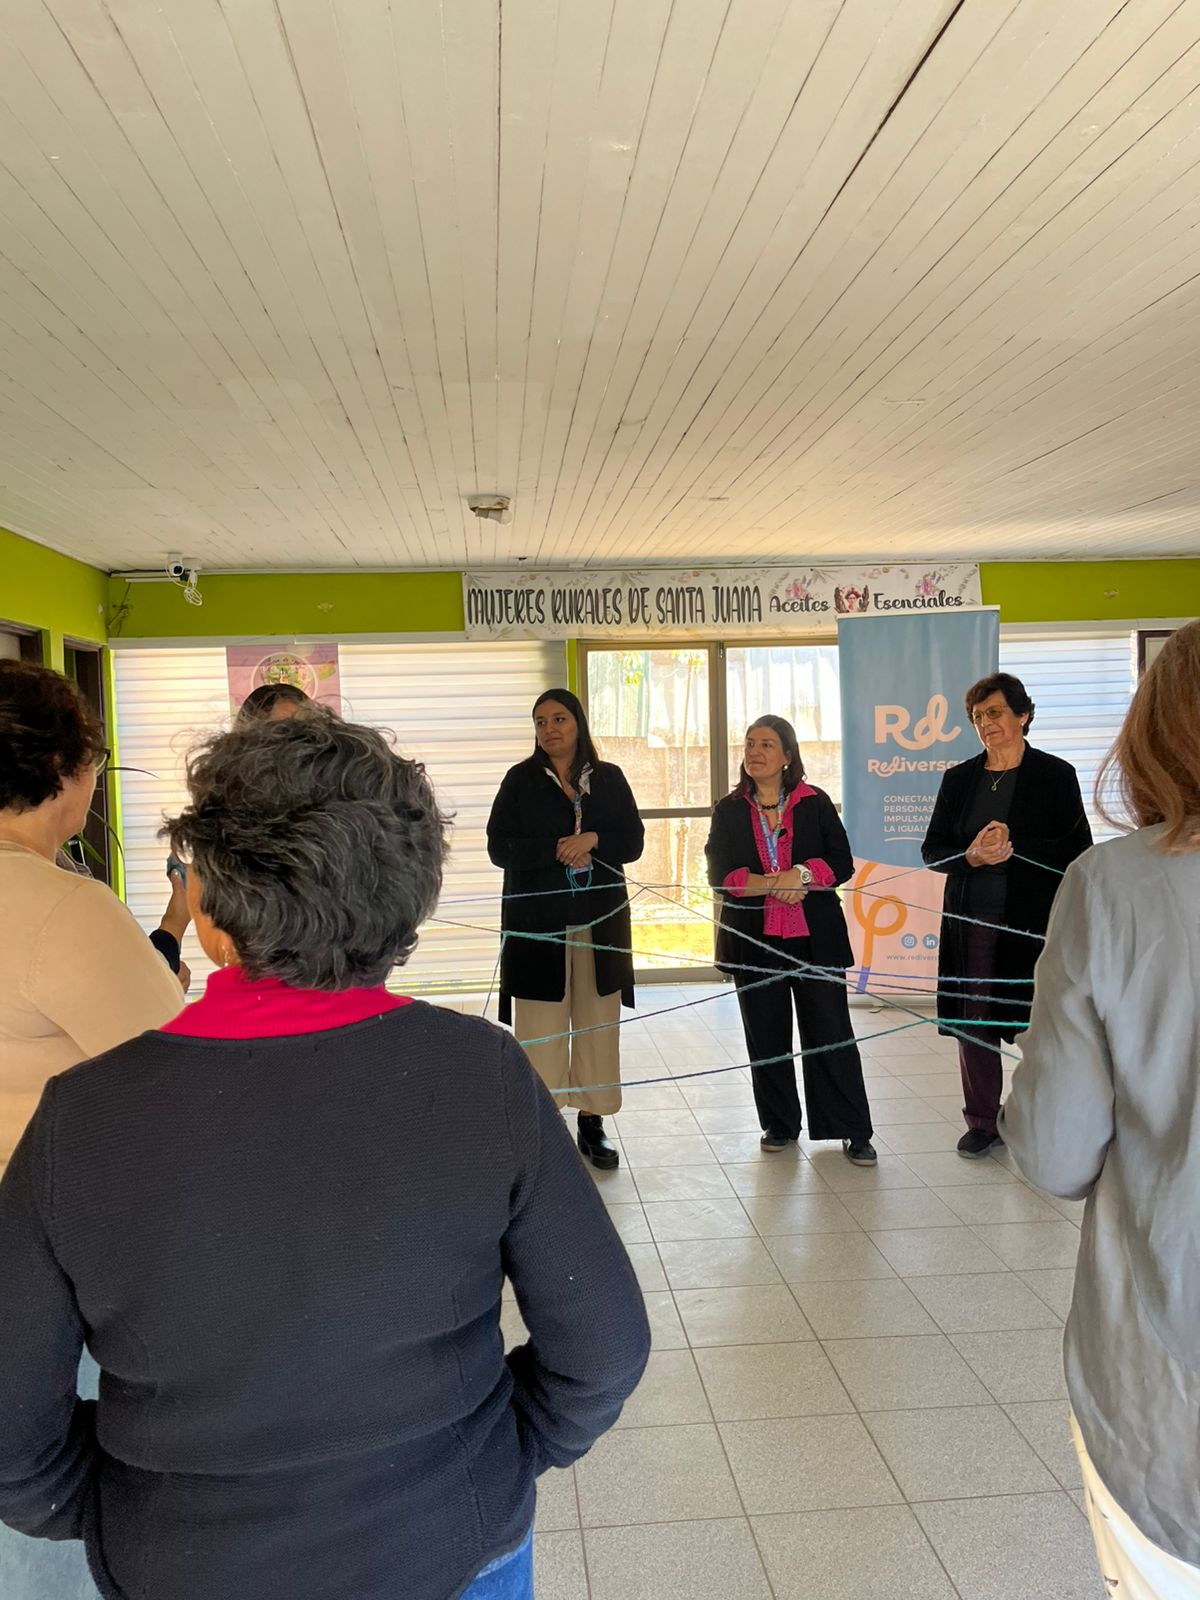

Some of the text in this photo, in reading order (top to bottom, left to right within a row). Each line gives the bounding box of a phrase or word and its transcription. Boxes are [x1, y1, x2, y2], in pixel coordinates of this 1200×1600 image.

[467, 585, 763, 625] MUJERES RURALES DE SANTA JUANA
[769, 589, 964, 613] Aceites Esenciales
[867, 756, 966, 778] Rediversa
[883, 795, 938, 804] CONECTAN
[883, 805, 935, 813] PERSONAS
[884, 825, 929, 833] LA IGUAL
